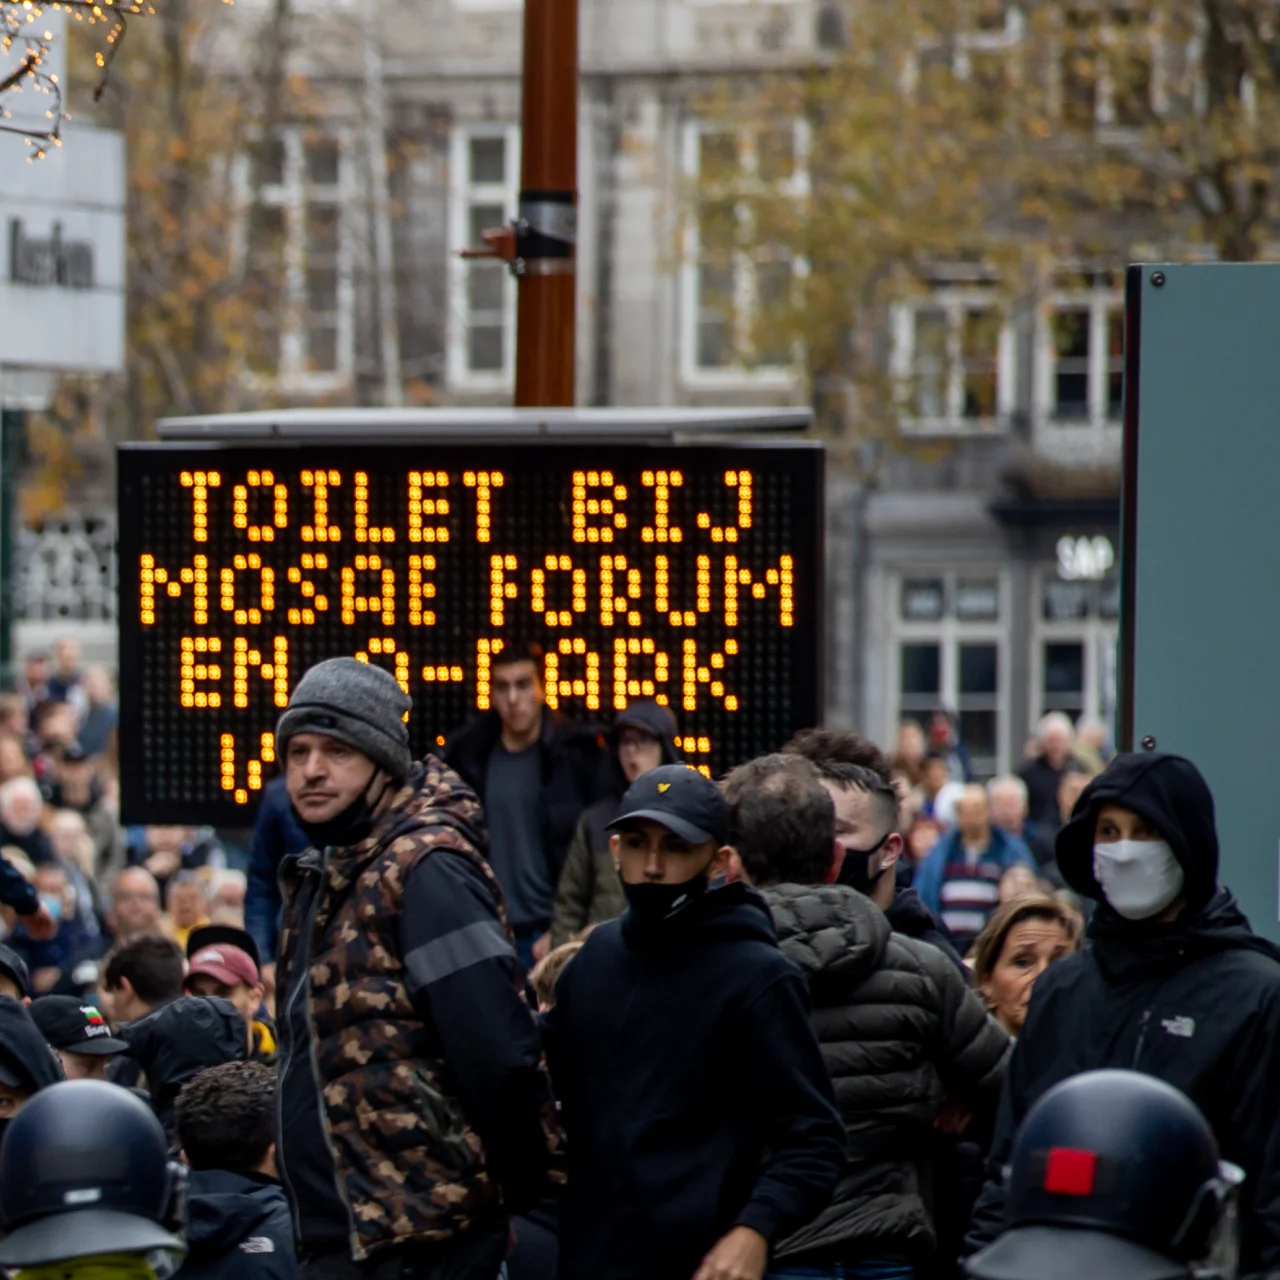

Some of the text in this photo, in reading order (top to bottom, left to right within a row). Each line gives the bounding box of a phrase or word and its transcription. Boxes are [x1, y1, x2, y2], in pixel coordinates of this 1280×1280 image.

[180, 470, 752, 543] TOILET BIJ
[140, 553, 794, 627] MOSAE FORUM
[180, 636, 289, 708] EN
